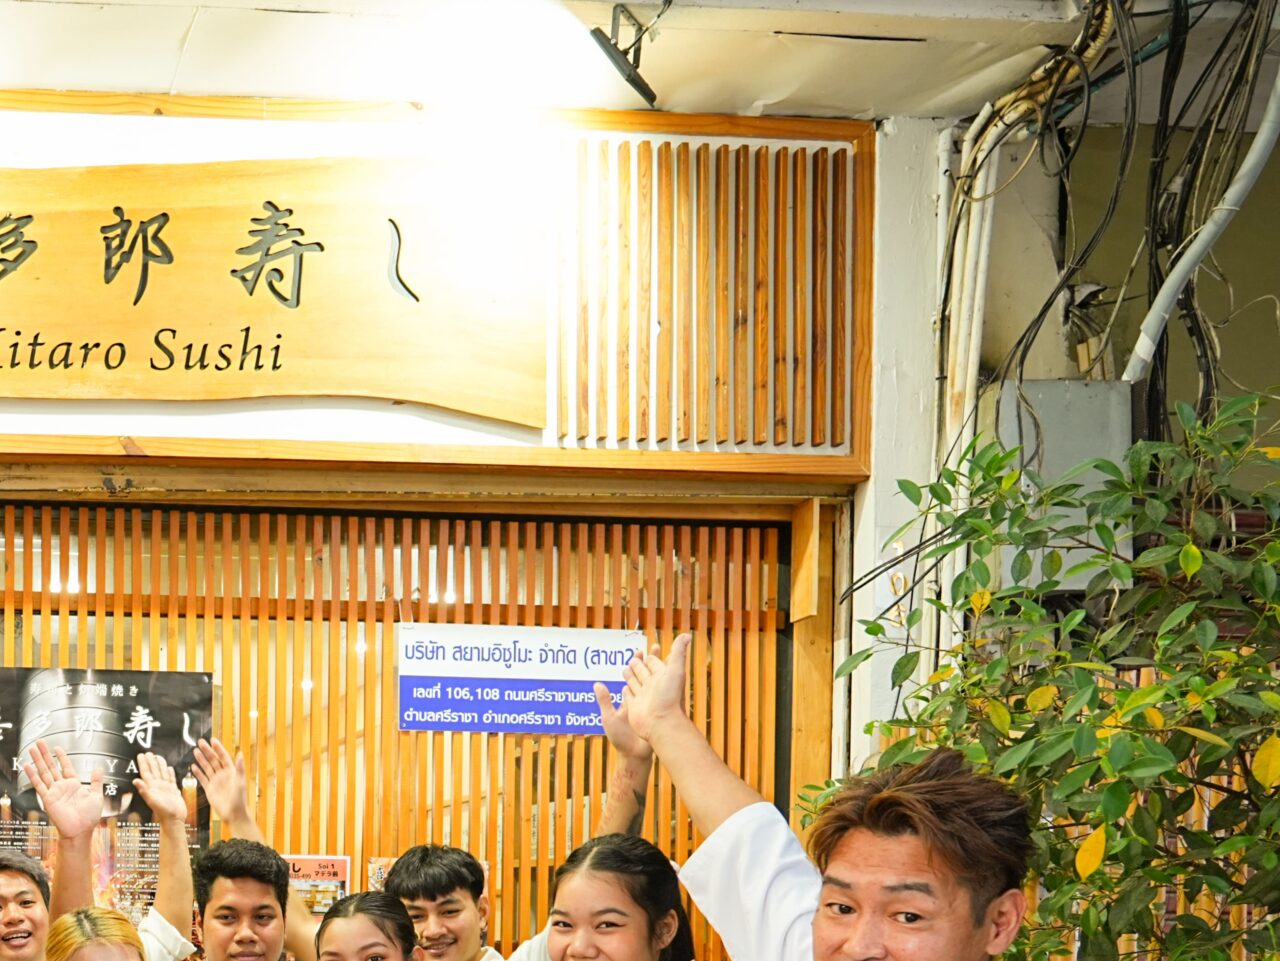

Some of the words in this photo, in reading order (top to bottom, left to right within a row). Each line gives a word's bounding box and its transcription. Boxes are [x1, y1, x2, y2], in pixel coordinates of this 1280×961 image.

[149, 327, 282, 371] Sushi
[405, 640, 446, 661] บริษัท
[539, 643, 577, 665] จำกัด
[583, 646, 639, 669] (สาขา2
[412, 682, 442, 699] เลขที่
[445, 686, 500, 701] 106,108
[403, 707, 478, 723] ตำบลศรีราชา
[482, 710, 562, 726] อำเภอศรีราชา
